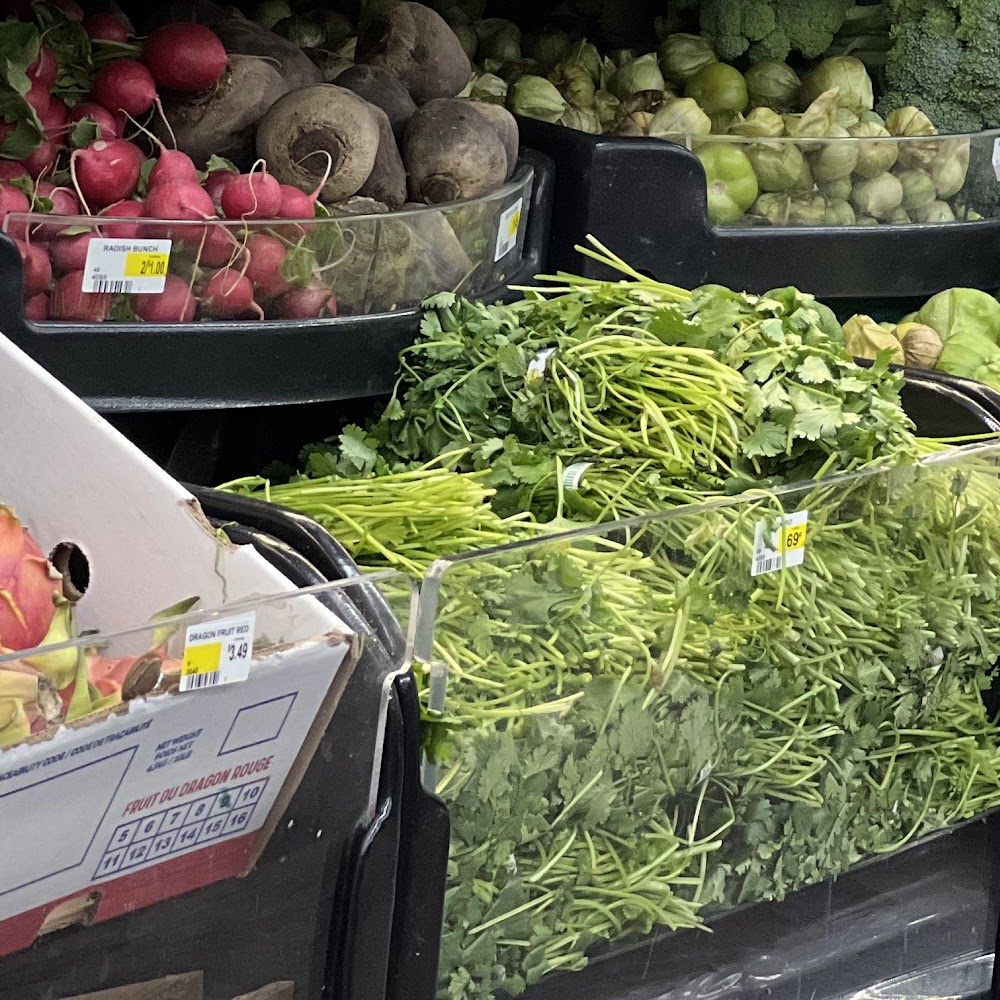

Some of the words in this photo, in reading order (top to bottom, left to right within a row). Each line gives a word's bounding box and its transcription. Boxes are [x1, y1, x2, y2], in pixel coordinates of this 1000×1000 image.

[103, 244, 132, 252] RADISH
[132, 244, 159, 252] BUNCH
[189, 630, 216, 643] DRAGON
[217, 626, 235, 637] FRUIT
[236, 624, 249, 634] RED
[227, 642, 248, 661] $3.49
[0, 761, 43, 781] CEABILITY
[121, 791, 161, 818] FRUIT
[161, 785, 180, 804] DU
[178, 768, 230, 798] DRAGON
[230, 755, 275, 781] ROUGE
[118, 829, 128, 842] 5
[143, 819, 154, 833] 6
[171, 811, 182, 825] 7
[243, 786, 261, 800] 10
[103, 854, 120, 870] 11
[129, 845, 147, 861] 12
[155, 837, 171, 852] 13
[180, 828, 196, 844] 14
[205, 820, 222, 834] 15
[230, 811, 247, 826] 16
